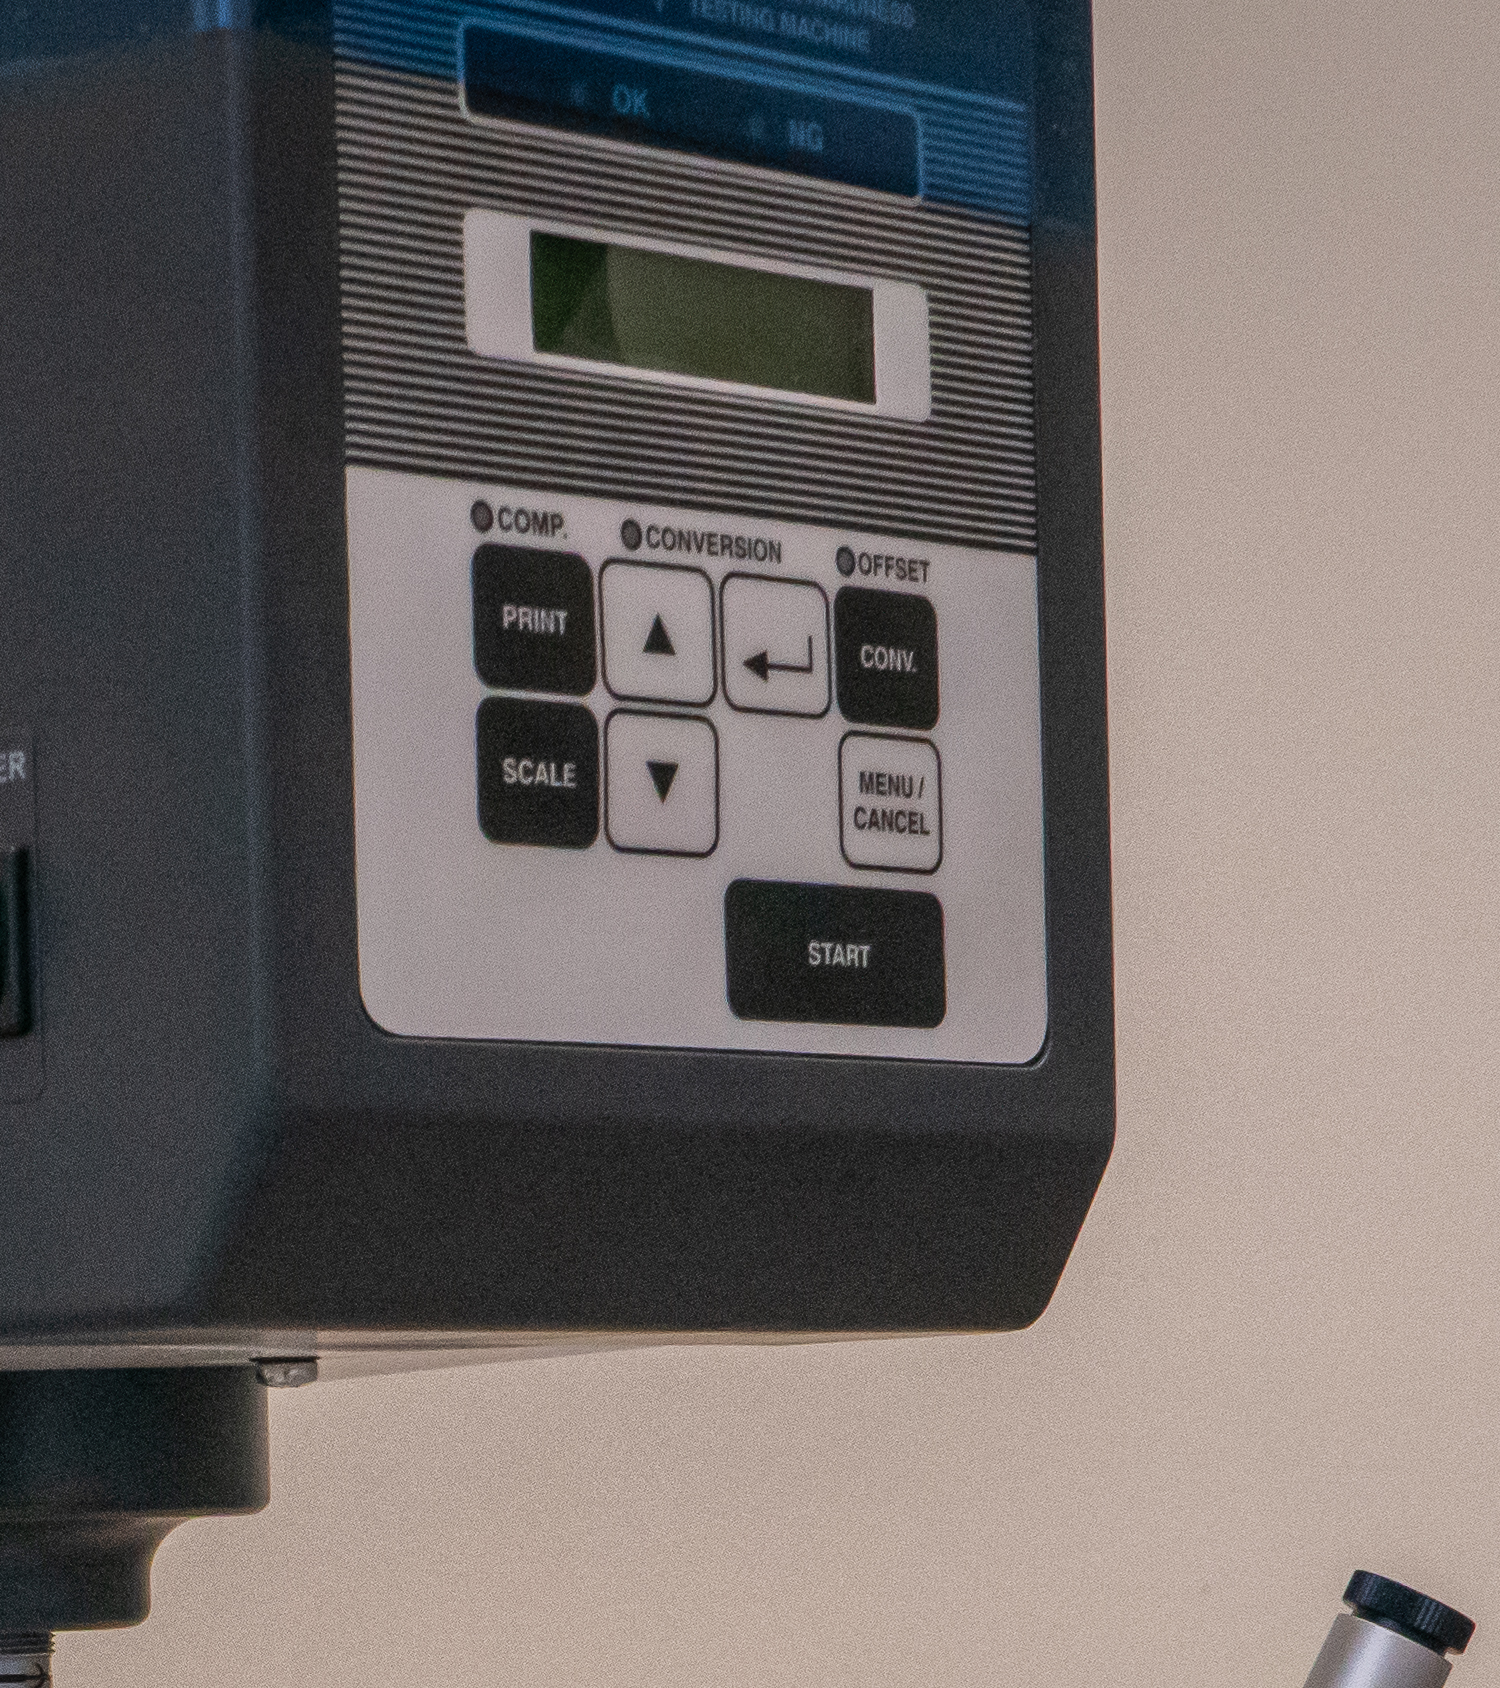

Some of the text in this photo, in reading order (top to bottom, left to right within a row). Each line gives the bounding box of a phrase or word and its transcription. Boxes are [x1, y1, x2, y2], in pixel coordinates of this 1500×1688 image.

[779, 10, 871, 53] MACHINE
[613, 84, 649, 117] OK
[787, 119, 824, 152] NG
[498, 507, 568, 539] COMP.
[647, 525, 781, 563] CONVERSION
[858, 552, 929, 583] OFFSET
[502, 605, 567, 636] PRINT
[861, 645, 918, 673] CONV.
[502, 757, 576, 789] SCALE
[860, 771, 914, 799] MENU
[854, 807, 930, 837] CANCEL
[808, 940, 871, 970] START
